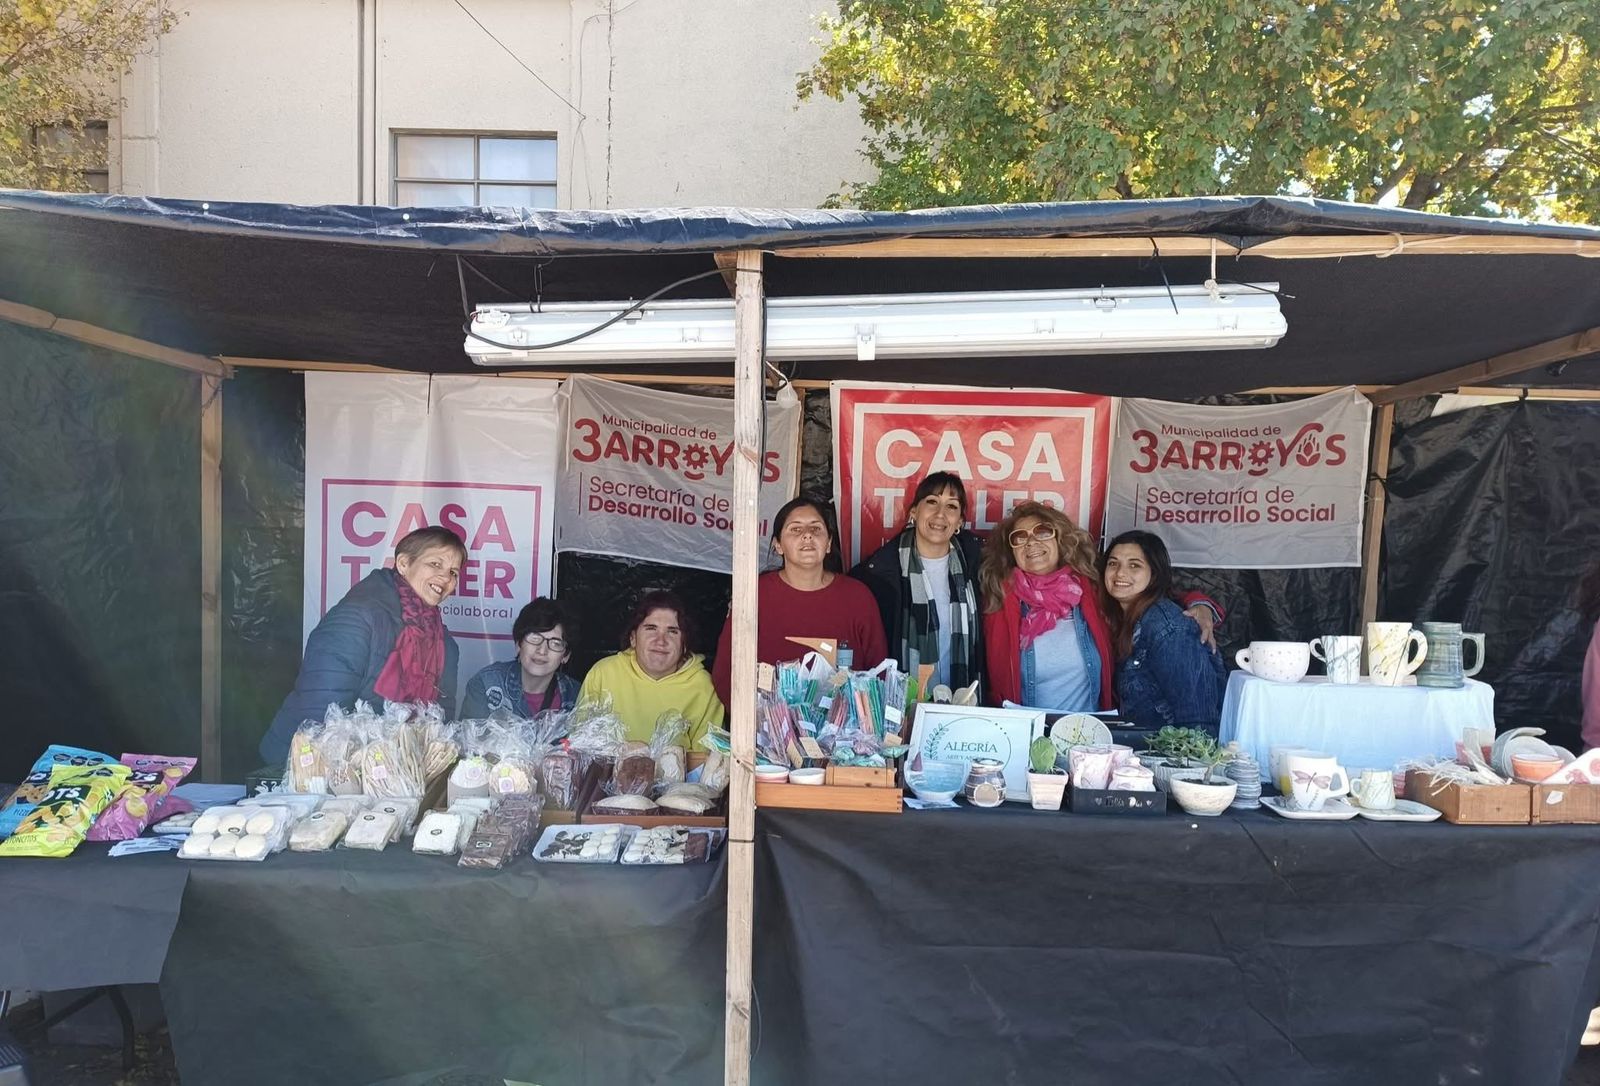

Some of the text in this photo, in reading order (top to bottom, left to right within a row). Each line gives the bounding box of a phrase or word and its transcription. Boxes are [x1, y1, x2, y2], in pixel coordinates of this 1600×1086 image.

[603, 414, 717, 440] Municipalidad de
[1161, 424, 1281, 438] Municipalidad de
[573, 418, 780, 482] 3ARROYS
[874, 429, 1065, 482] CASA
[590, 476, 730, 512] Secretaría de
[1147, 485, 1295, 505] Secretaría de
[341, 501, 516, 552] CASA
[588, 495, 768, 537] Desarrollo Sol
[1145, 503, 1336, 524] Desarrollo Social
[341, 556, 516, 599] TER
[944, 741, 998, 753] ALEGRÍA
